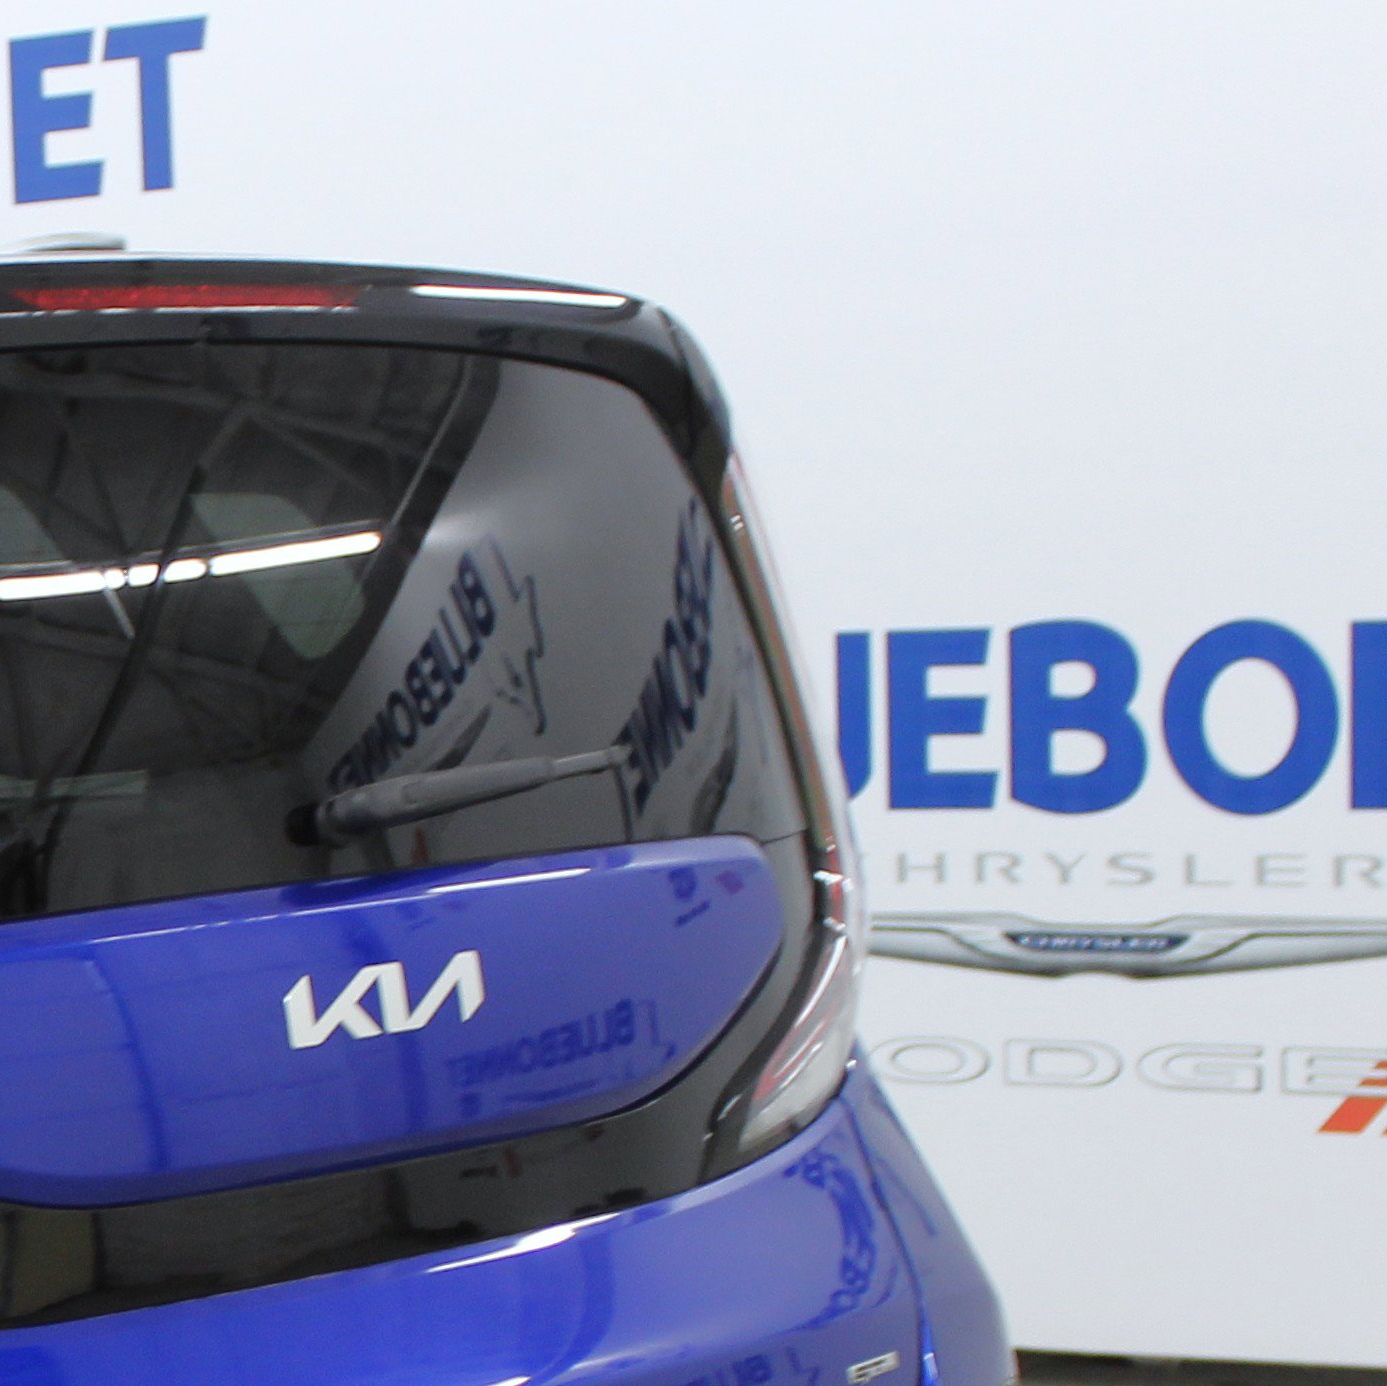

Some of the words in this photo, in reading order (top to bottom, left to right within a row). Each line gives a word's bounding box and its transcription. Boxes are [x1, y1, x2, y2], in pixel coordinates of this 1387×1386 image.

[836, 617, 1387, 815] EBO
[863, 851, 1387, 888] HRYSLER
[282, 949, 486, 1050] KIA
